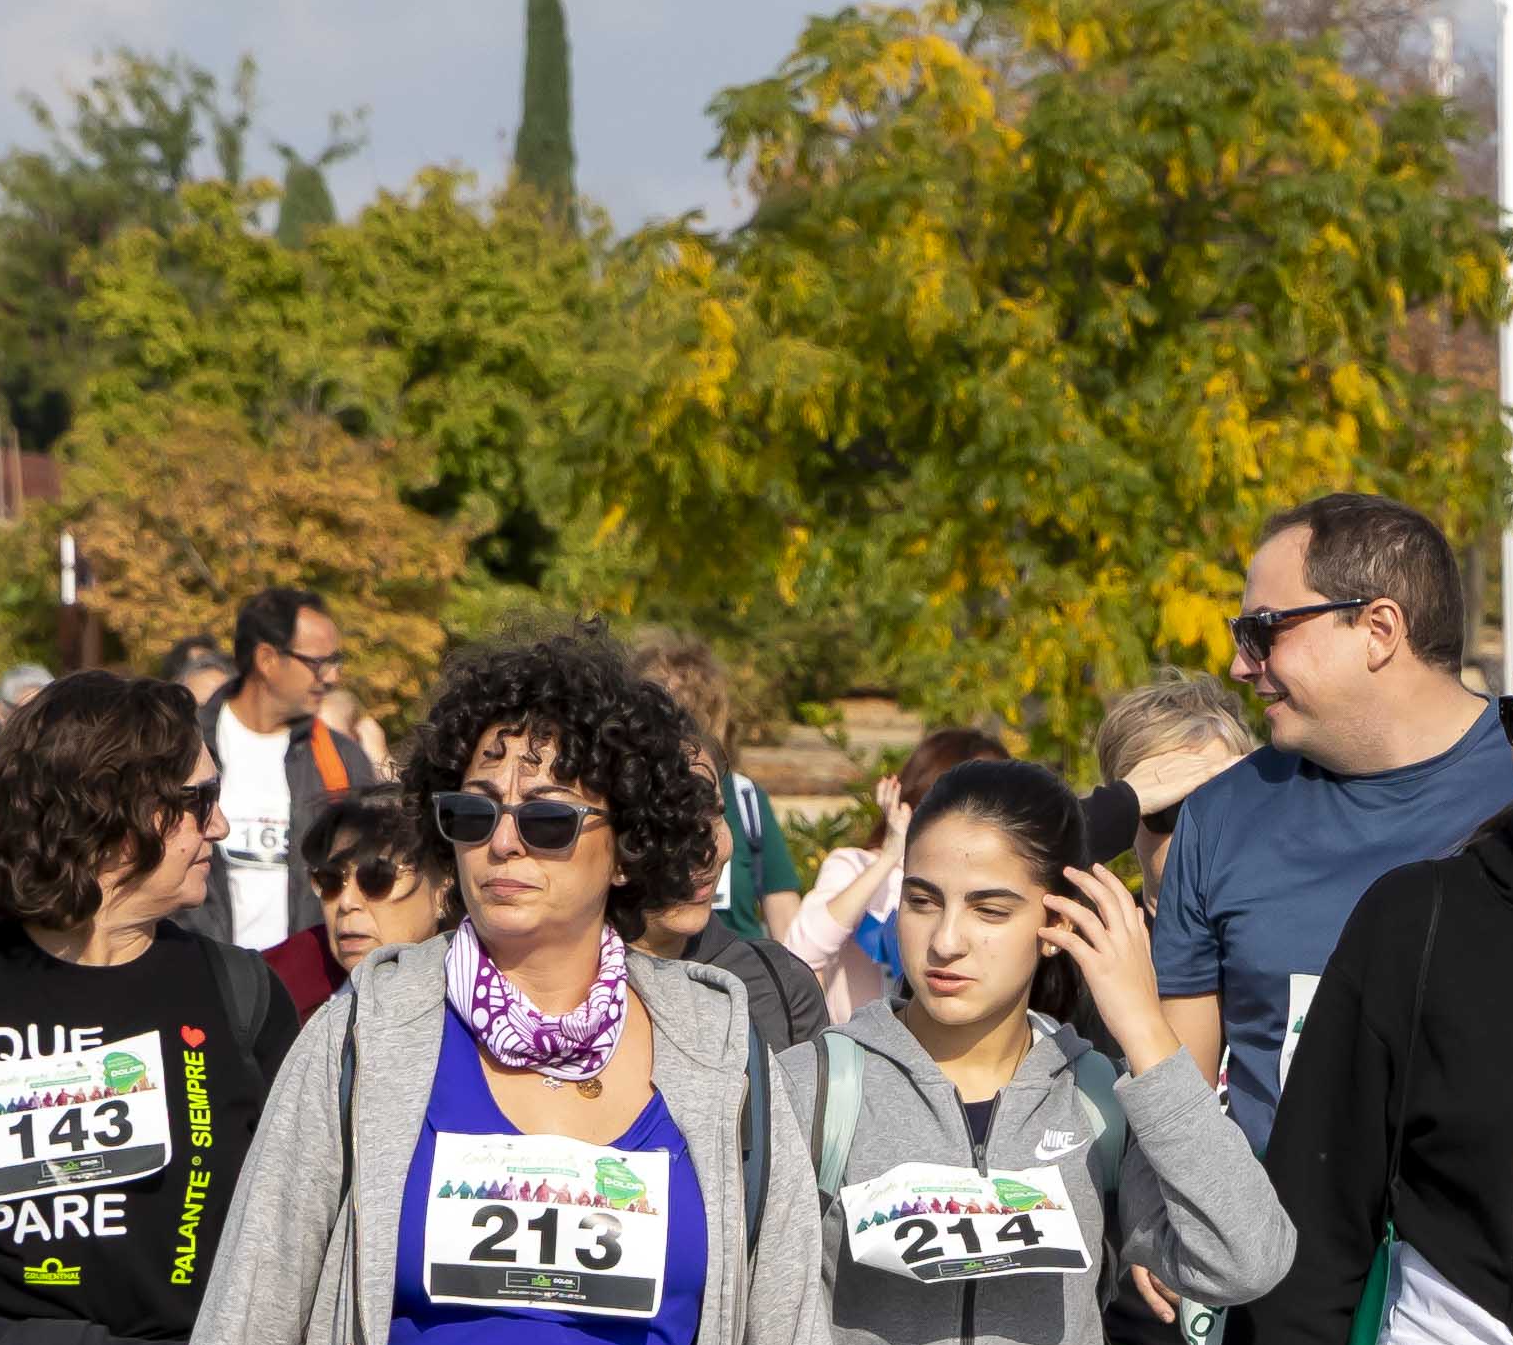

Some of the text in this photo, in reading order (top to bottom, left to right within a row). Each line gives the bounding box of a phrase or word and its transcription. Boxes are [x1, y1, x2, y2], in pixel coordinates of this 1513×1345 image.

[8, 1099, 134, 1160] 143
[1043, 1128, 1075, 1149] NIKE
[171, 1050, 213, 1285] PALANTE SIEMPRE
[469, 1204, 623, 1271] 213
[894, 1214, 1044, 1264] 214
